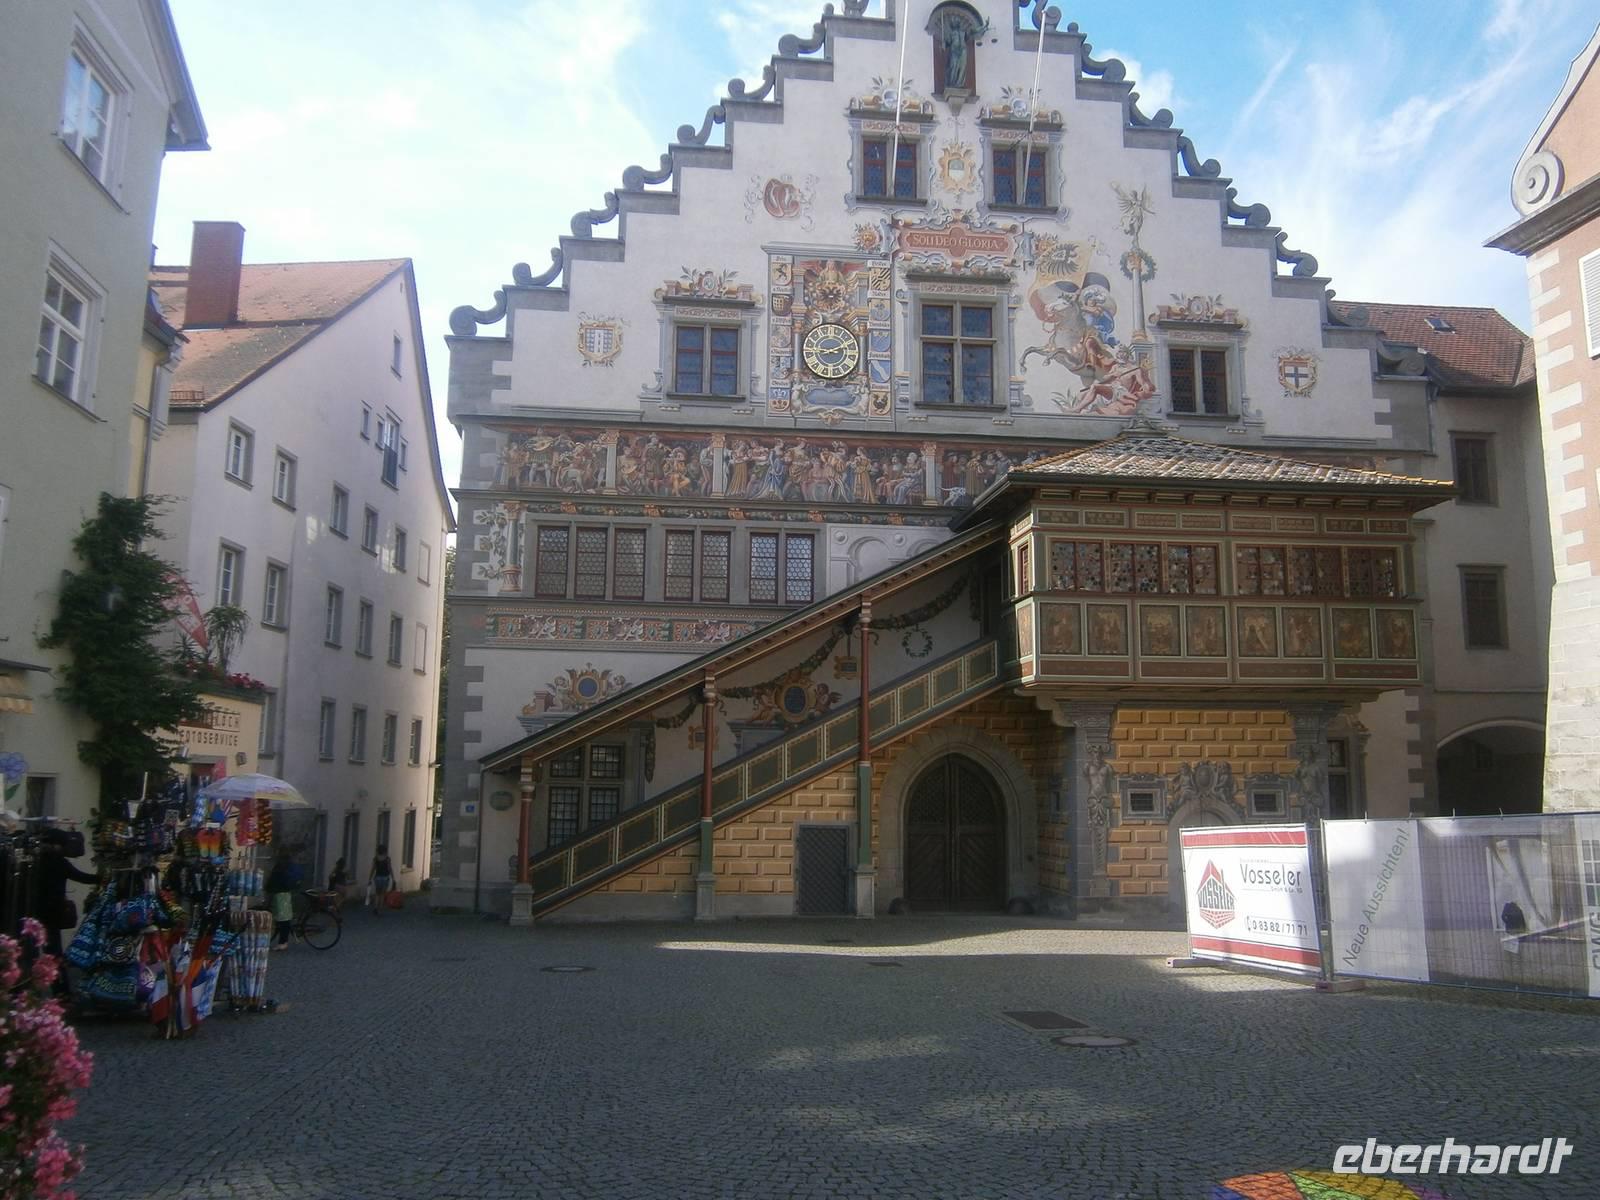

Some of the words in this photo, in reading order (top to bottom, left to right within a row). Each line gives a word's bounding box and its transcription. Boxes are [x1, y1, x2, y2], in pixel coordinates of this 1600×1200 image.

[936, 236, 957, 247] DEO
[959, 237, 999, 249] GLORIA
[1240, 863, 1301, 886] Vosseler
[1342, 924, 1369, 967] Neue
[1362, 828, 1410, 923] Aussichten!
